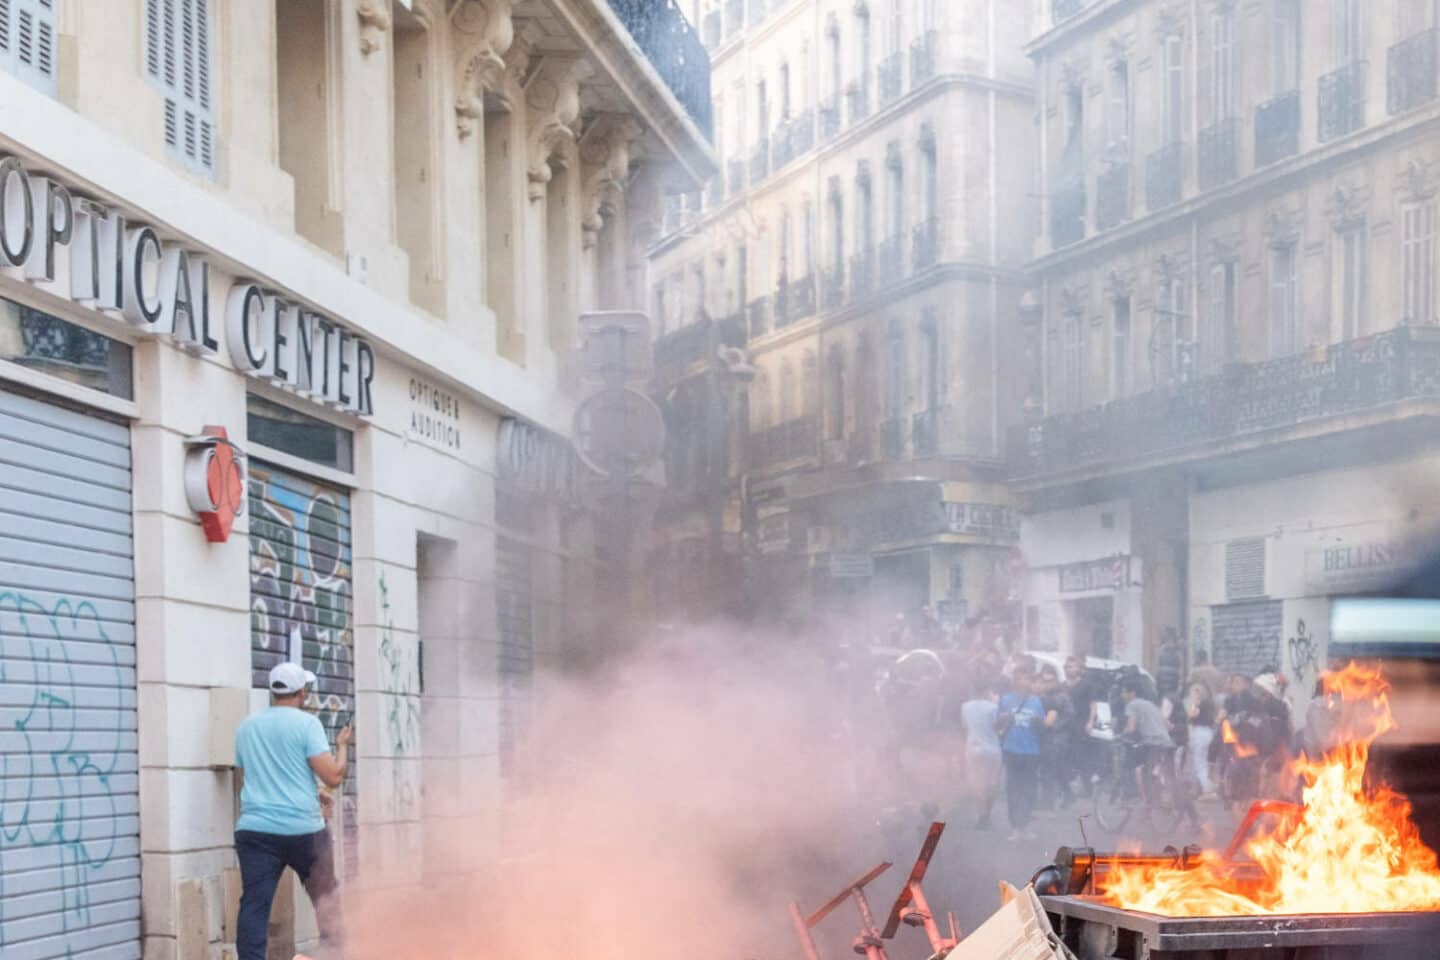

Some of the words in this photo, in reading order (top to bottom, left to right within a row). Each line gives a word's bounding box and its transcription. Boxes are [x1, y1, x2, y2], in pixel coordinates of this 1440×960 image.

[0, 157, 218, 352] OPTICAL
[228, 284, 374, 416] CENTER
[409, 377, 452, 416] OPTIQUE
[411, 411, 461, 450] AUDITION
